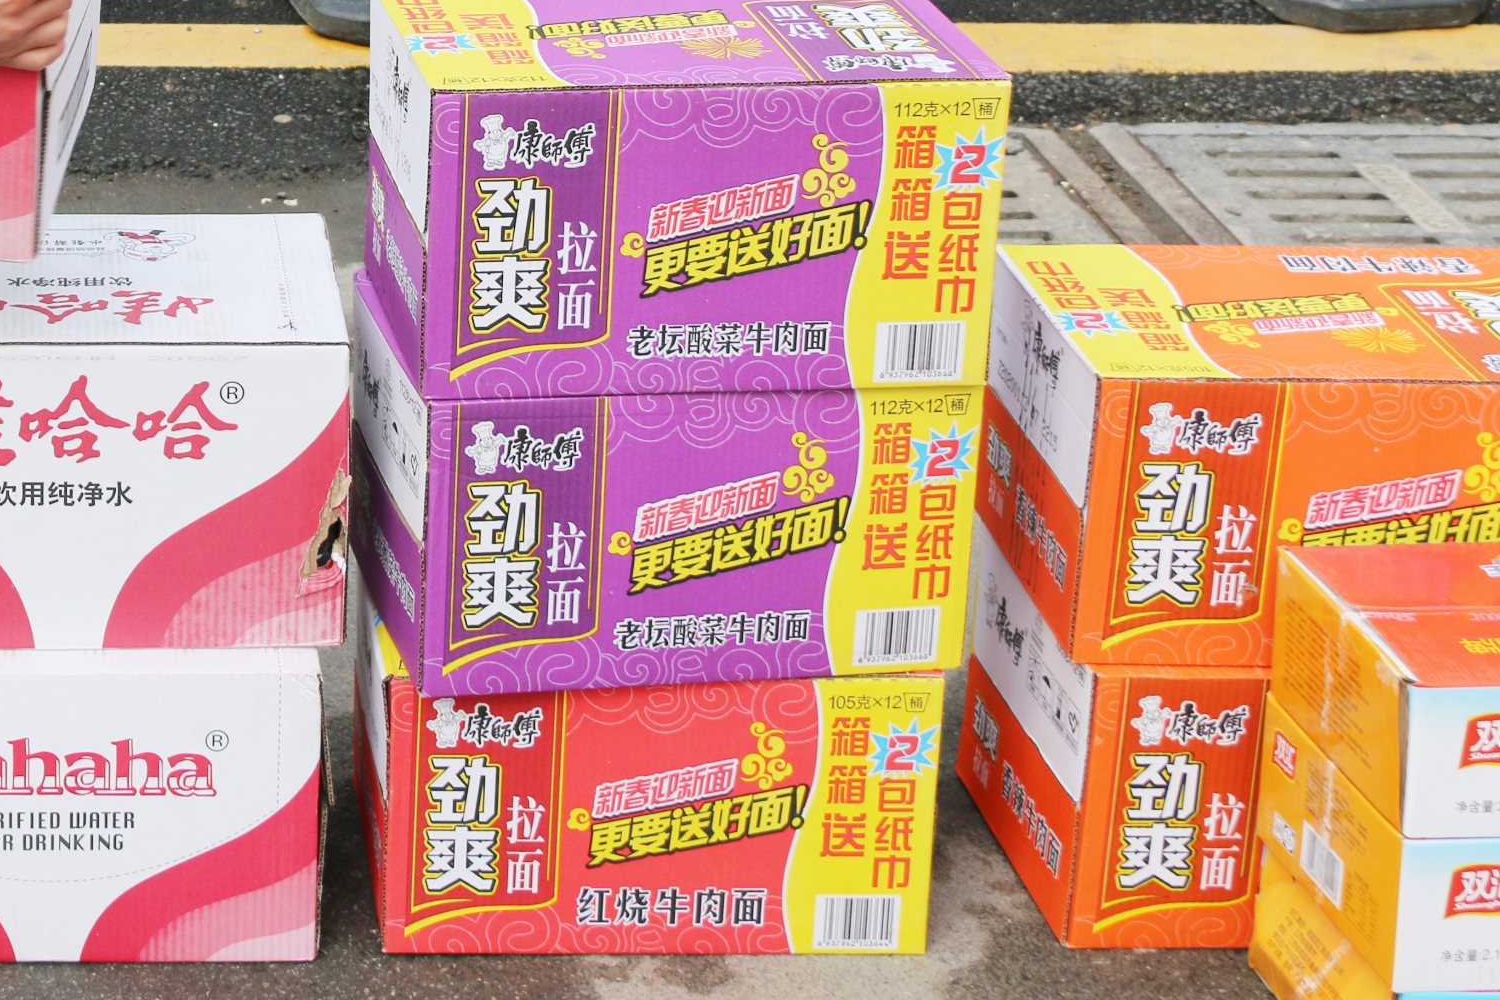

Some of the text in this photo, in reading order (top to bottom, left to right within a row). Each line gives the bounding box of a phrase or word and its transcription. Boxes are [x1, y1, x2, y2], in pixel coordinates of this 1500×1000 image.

[647, 174, 800, 242] 新春迎新面
[882, 125, 937, 280] 箱箱送
[7, 276, 133, 289] 饮用纯净水
[471, 177, 552, 331] 劲爽
[557, 221, 598, 331] 拉面
[1280, 254, 1482, 276] 香辣牛肉面
[626, 321, 833, 358] 老坛酸菜牛肉面
[1252, 309, 1388, 335] 新春迎新面
[1401, 289, 1480, 335] 拉面
[633, 471, 781, 541] 新春迎新面
[861, 422, 912, 571] 箱箱送
[1126, 461, 1215, 607] 劲爽
[1303, 470, 1463, 530] 新春迎新面
[462, 479, 543, 630] 劲爽
[546, 521, 587, 626] 拉面
[1210, 504, 1260, 607] 拉面
[612, 609, 810, 651] 老坛酸菜牛肉面
[69, 810, 136, 829] WATER
[422, 753, 503, 897] 劲爽
[593, 757, 740, 818] 新春迎新面
[819, 717, 871, 857] 箱箱送
[1001, 758, 1064, 879] 香辣牛肉面
[1114, 751, 1204, 891] 劲爽
[22, 833, 125, 851] DRINKING
[505, 795, 546, 895] 拉面
[1199, 793, 1247, 891] 拉面
[576, 886, 768, 928] 红烧牛肉面
